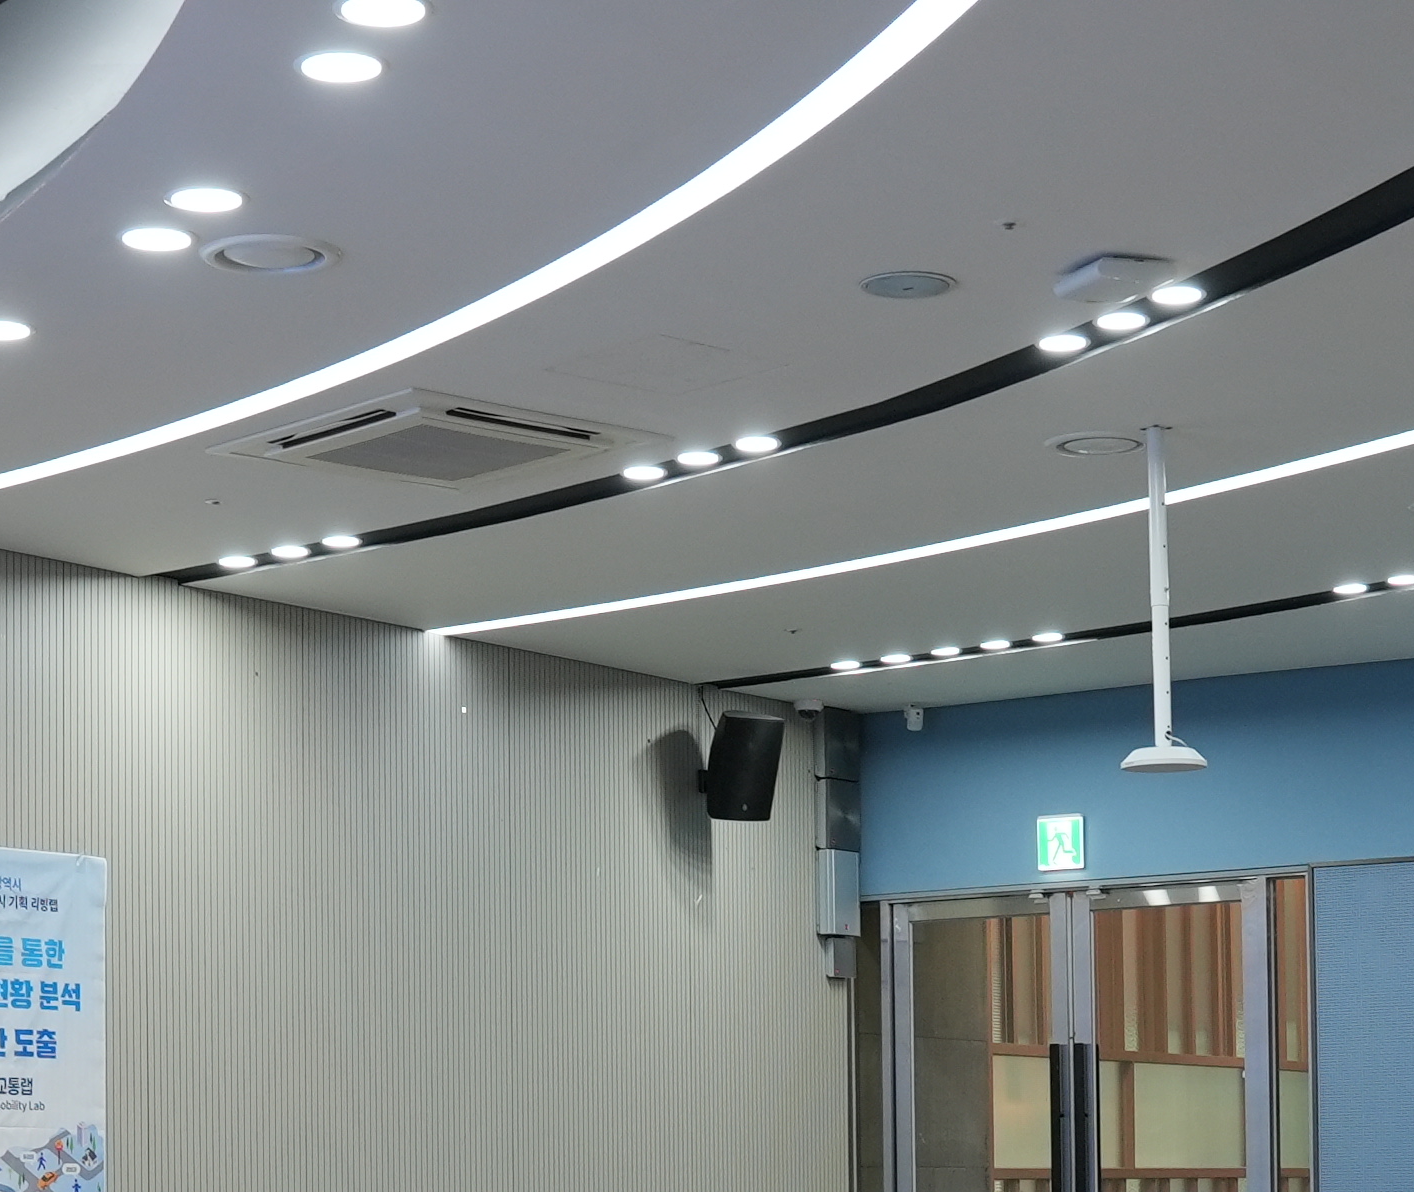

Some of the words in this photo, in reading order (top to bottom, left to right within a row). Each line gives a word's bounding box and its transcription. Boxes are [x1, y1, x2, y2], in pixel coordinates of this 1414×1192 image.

[8, 895, 28, 910] 기획
[31, 897, 59, 912] 리빙랩
[21, 937, 65, 969] 통한
[39, 981, 81, 1011] 분석
[14, 1028, 57, 1059] 도출
[29, 1101, 45, 1111] Lab
